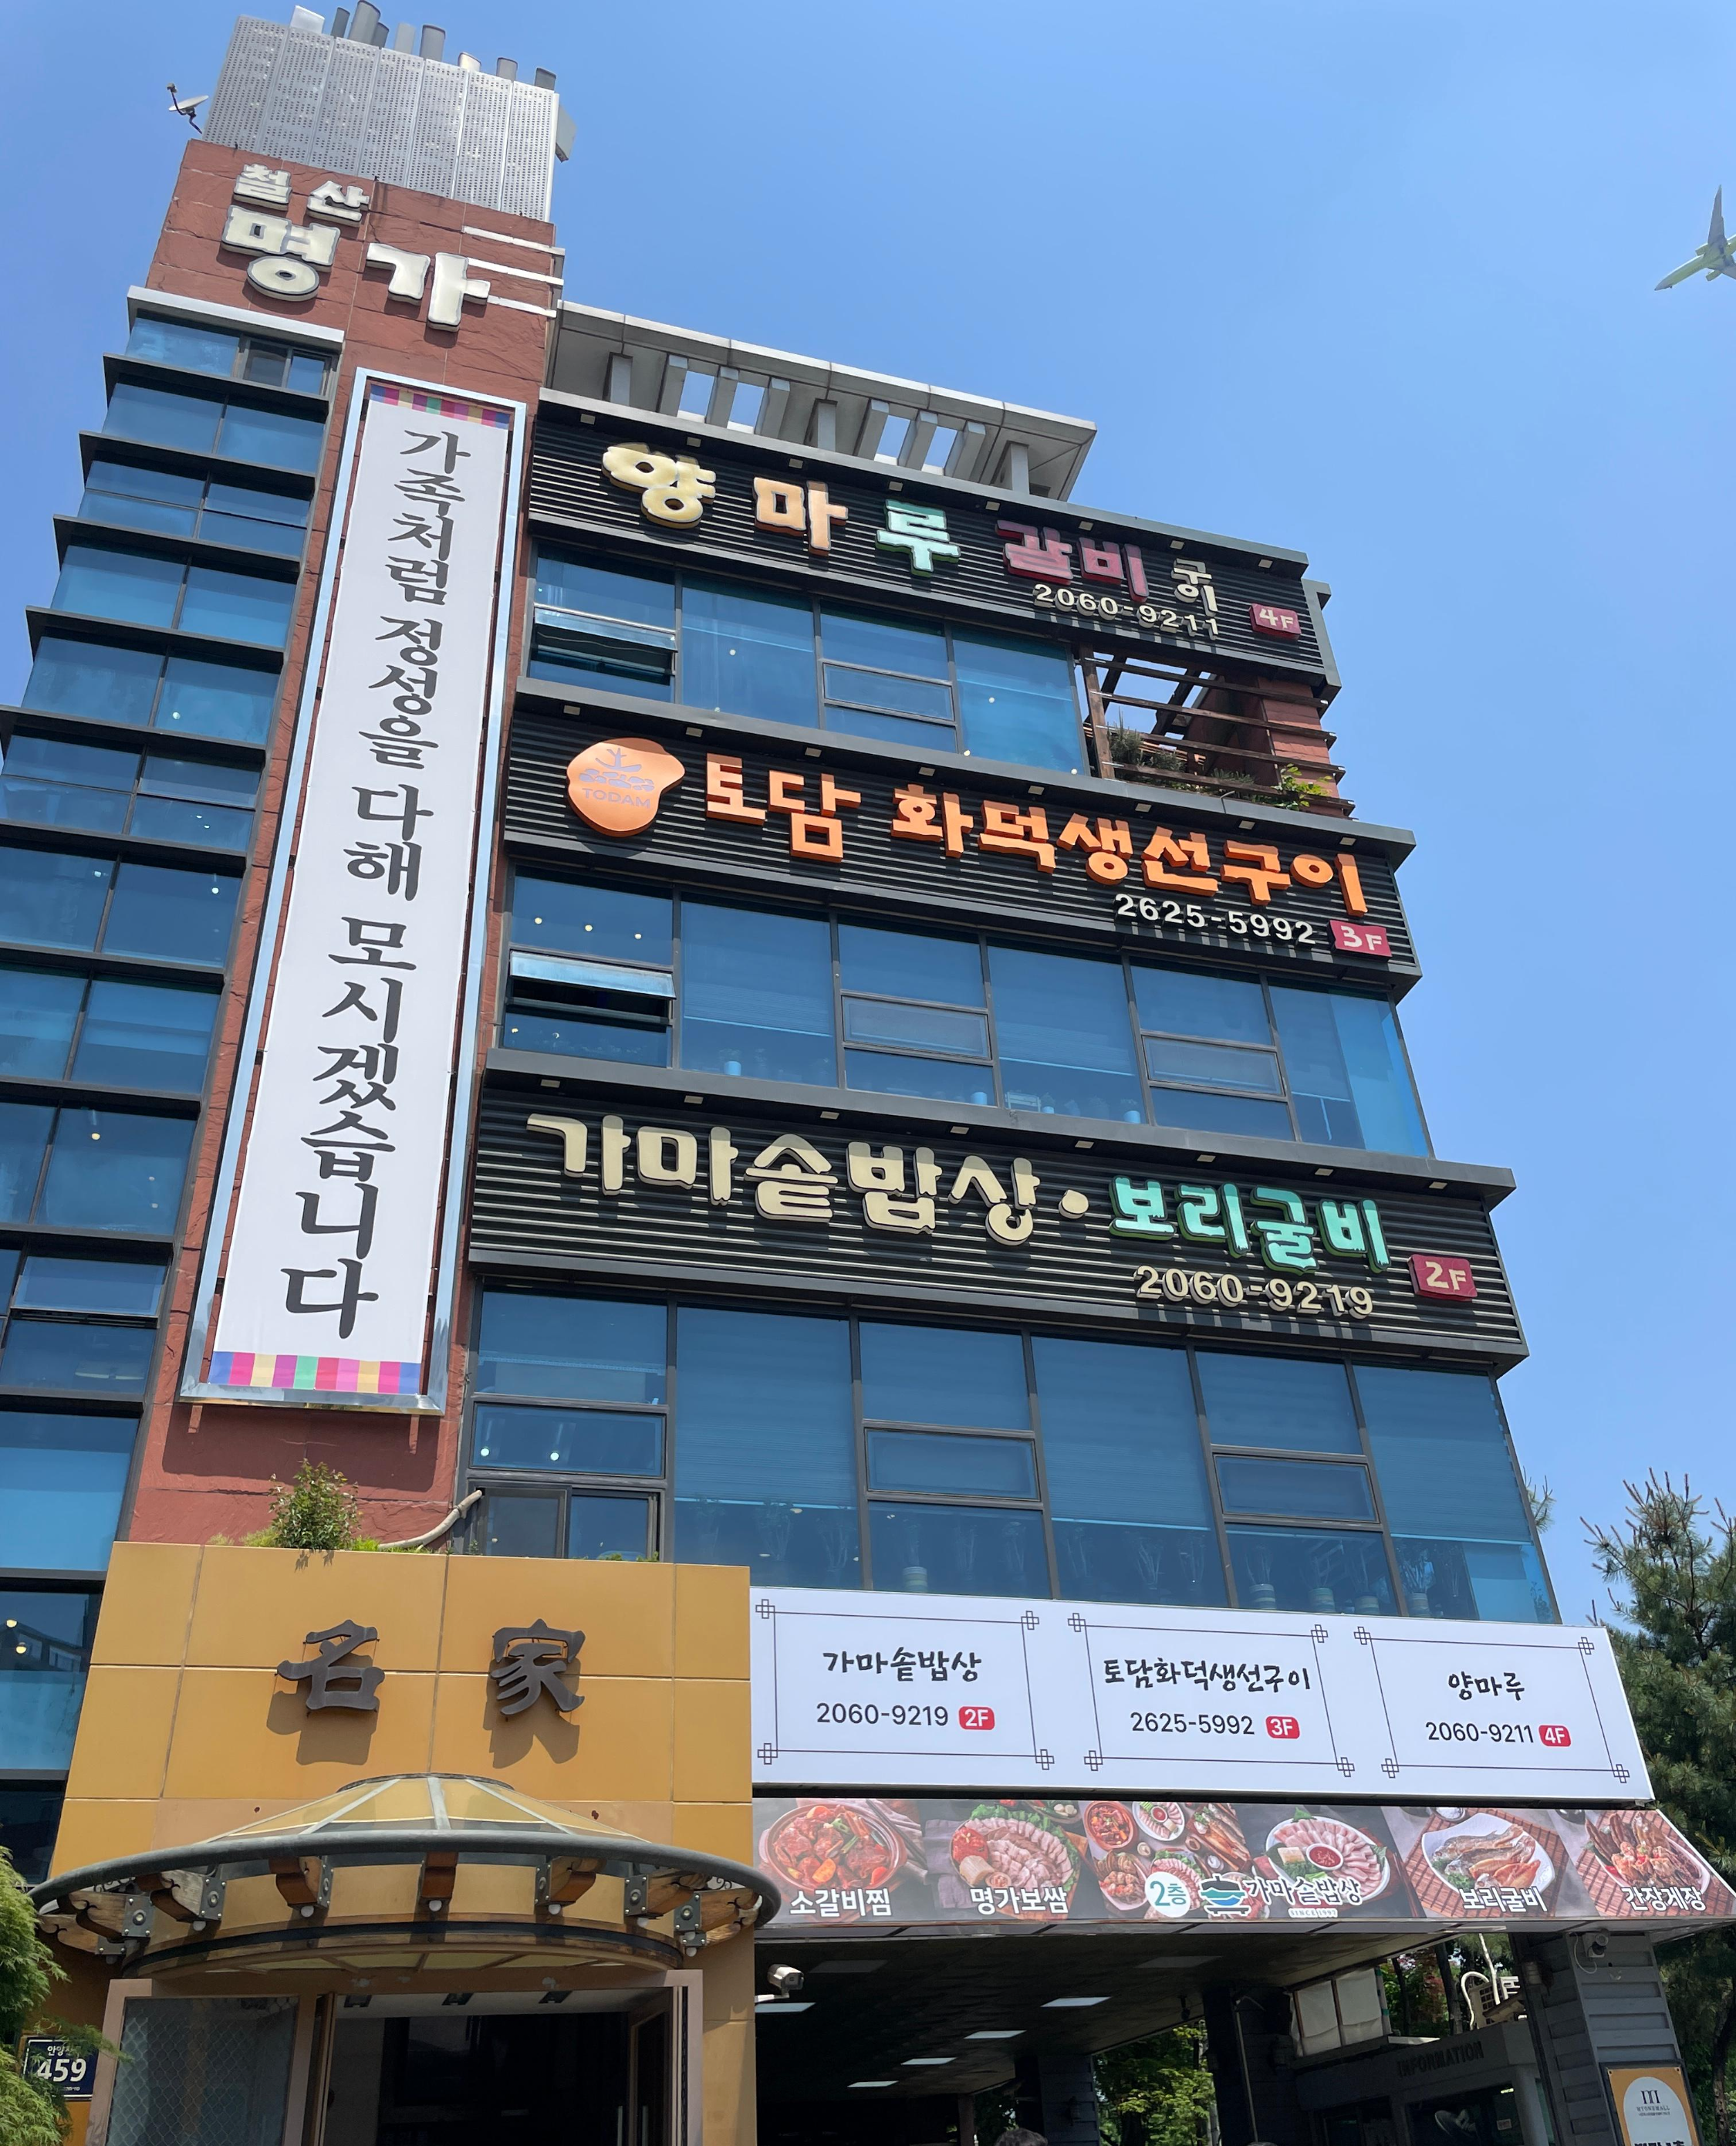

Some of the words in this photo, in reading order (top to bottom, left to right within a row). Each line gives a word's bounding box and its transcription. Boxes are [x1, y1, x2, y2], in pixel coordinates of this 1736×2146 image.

[233, 164, 370, 227] 철산
[221, 204, 491, 332] 명가
[385, 430, 471, 606] 가족처럼
[995, 519, 1150, 603] 갈비
[1033, 583, 1219, 640] 2060-9211
[1259, 607, 1294, 630] 4F
[358, 616, 443, 769] 정성을
[583, 787, 650, 809] TODAM
[706, 753, 861, 863] 토담
[343, 784, 434, 901] 다해
[1114, 894, 1316, 949] 2625-5992
[1340, 925, 1383, 951] 3F
[280, 917, 417, 1340] 모시겠습니다
[1109, 1175, 1391, 1276] 보리굴비
[1133, 1264, 1373, 1320] 2060-9219
[1425, 1260, 1467, 1290] 2F
[276, 1619, 586, 1715] 名家
[822, 1646, 982, 1682] 가마솥밥상
[1103, 1657, 1311, 1693] 토담화덕생선구이
[1447, 1671, 1525, 1702] 양마루
[816, 1702, 949, 1726] 2060-9219
[964, 1708, 989, 1727] 2F
[1130, 1712, 1255, 1735] 2625-5992
[1269, 1718, 1293, 1736] 3F
[1425, 1722, 1534, 1744] 2060-9211
[1544, 1727, 1566, 1744] 4F
[789, 1887, 892, 1918] 소갈비찜
[970, 1887, 1070, 1916] 명가보쌈
[1149, 1880, 1187, 1908] 2층
[1245, 1876, 1363, 1904] 가마솥밥상
[1458, 1886, 1547, 1913] 보리굴비
[1621, 1886, 1706, 1913] 간장게장
[37, 2058, 86, 2082] 459
[1396, 2041, 1484, 2077] INFORMATION
